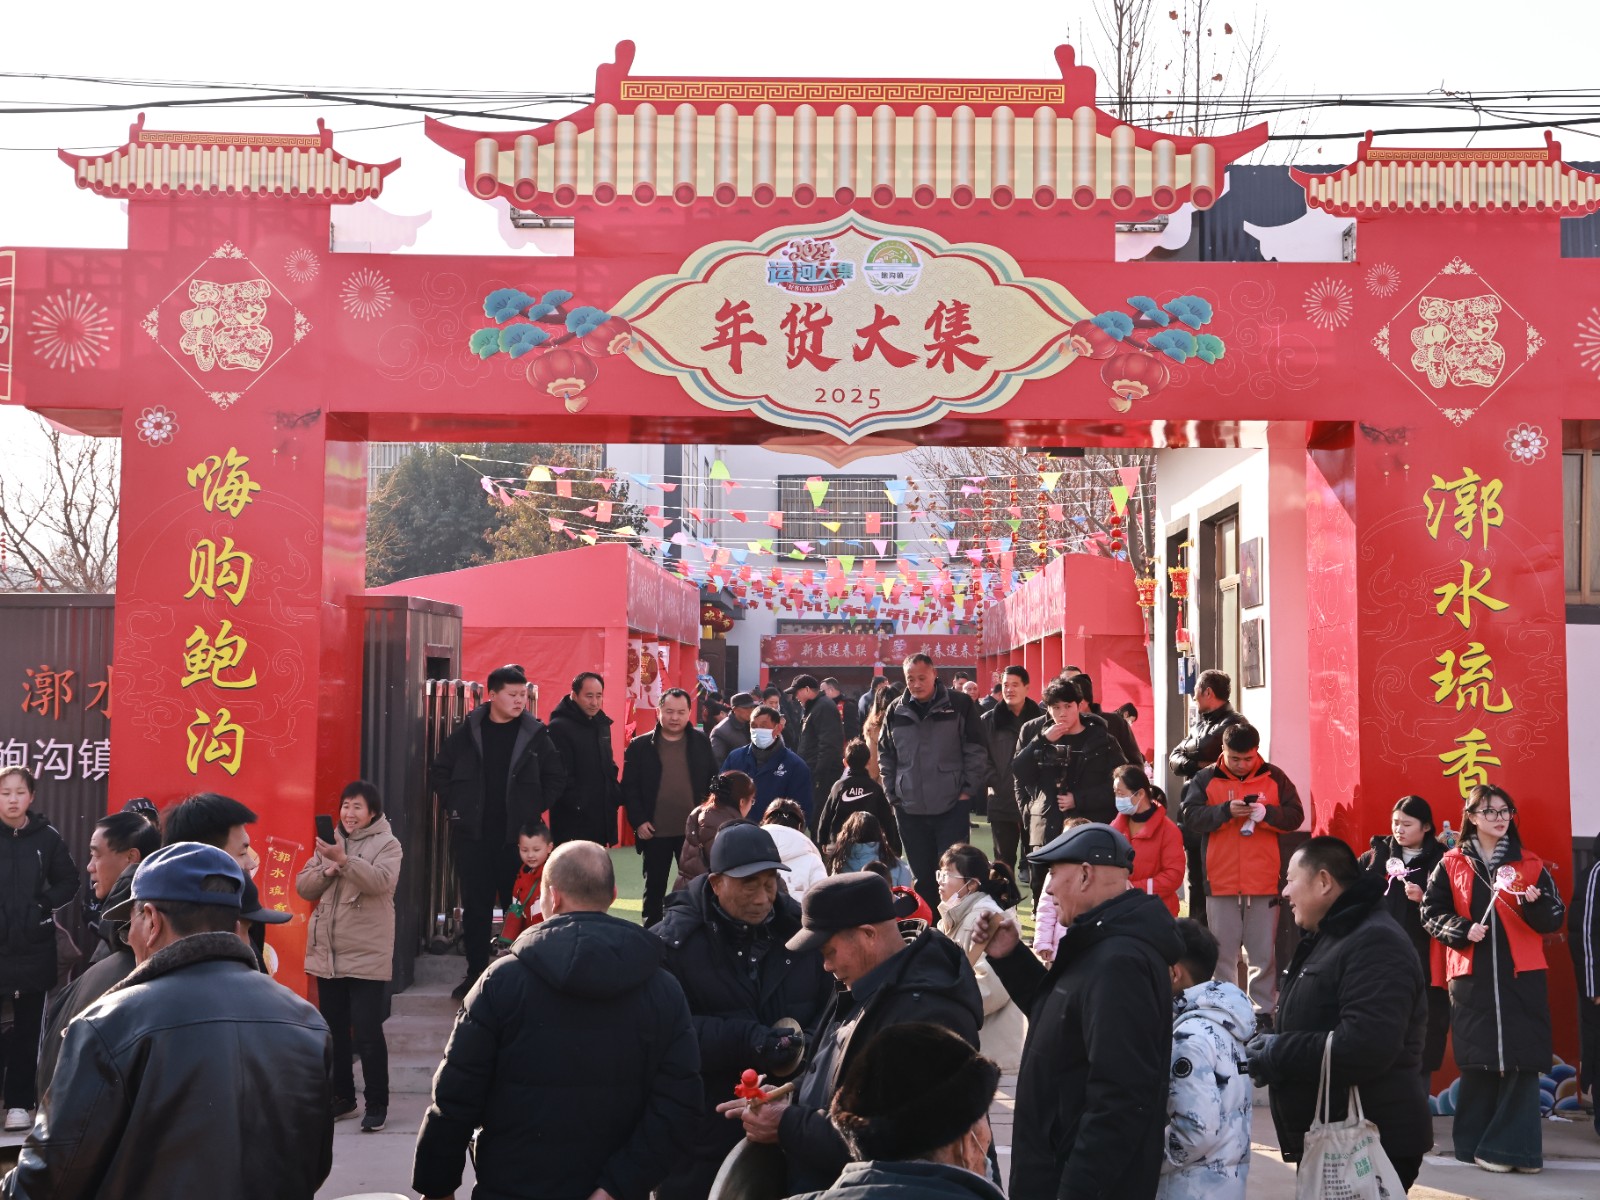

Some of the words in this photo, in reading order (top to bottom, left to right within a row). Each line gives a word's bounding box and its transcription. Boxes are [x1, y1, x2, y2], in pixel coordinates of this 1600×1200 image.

[768, 261, 853, 283] 运河大集
[700, 298, 993, 375] 年货大集
[814, 387, 882, 410] 2025
[181, 446, 261, 776] 嗨购鲍沟
[1422, 466, 1514, 800] 漷水琉香
[800, 642, 867, 659] 新春送春联
[849, 787, 864, 796] AIR
